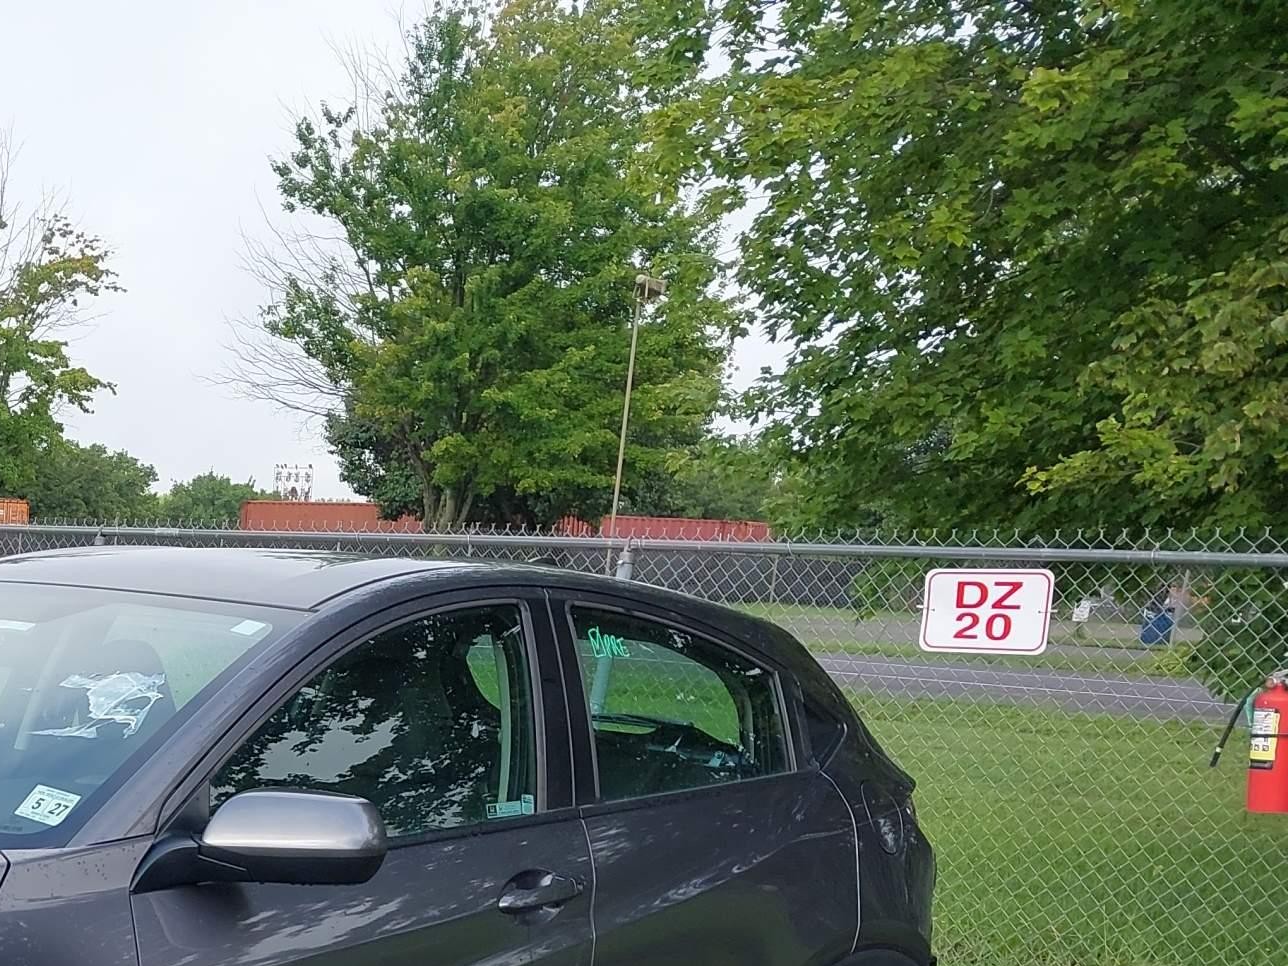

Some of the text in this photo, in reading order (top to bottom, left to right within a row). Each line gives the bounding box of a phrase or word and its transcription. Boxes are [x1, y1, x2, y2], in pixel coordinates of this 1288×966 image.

[956, 581, 1023, 609] DZ
[953, 612, 1012, 640] 20
[32, 798, 46, 810] 5
[47, 803, 70, 817] 27
